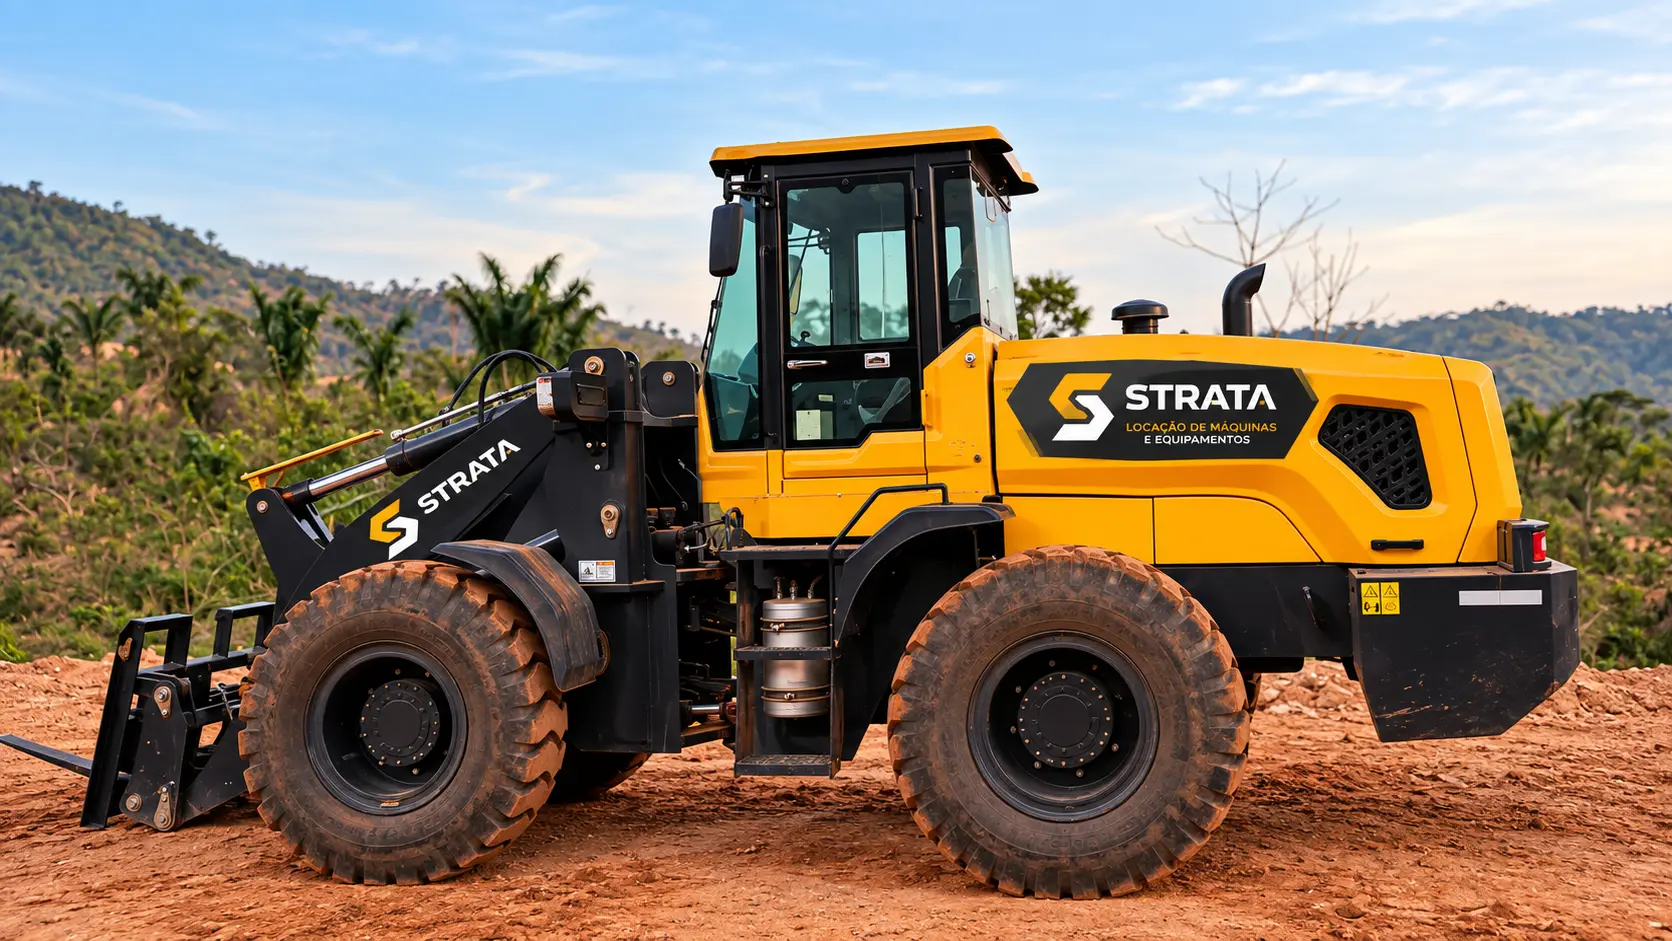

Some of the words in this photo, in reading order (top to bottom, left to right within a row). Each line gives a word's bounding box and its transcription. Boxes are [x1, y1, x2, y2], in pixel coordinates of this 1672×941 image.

[1126, 384, 1277, 410] STRATA
[1126, 420, 1186, 434] LOCAÇÃO
[1190, 423, 1207, 432] DE
[1211, 420, 1277, 433] MÁQUINAS
[1144, 435, 1151, 444] E
[1155, 435, 1251, 445] EQUIPAMENTOS
[417, 438, 521, 515] STRATA
